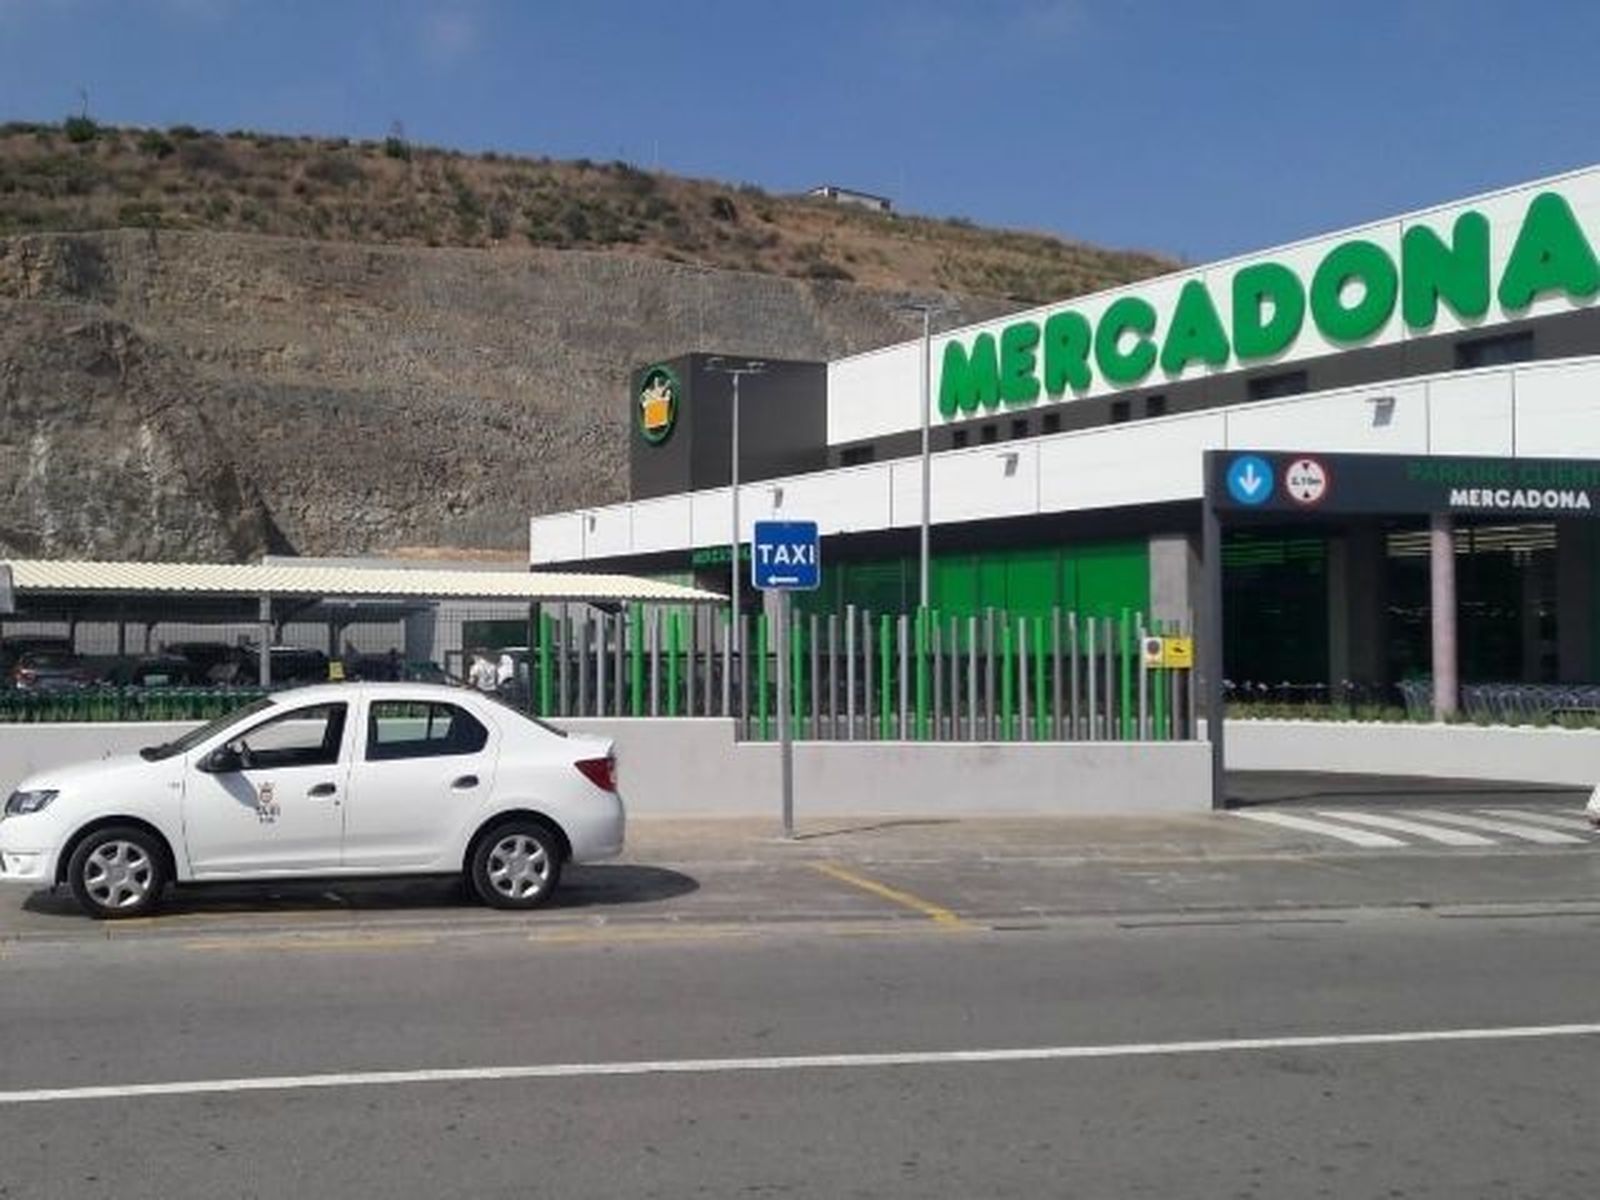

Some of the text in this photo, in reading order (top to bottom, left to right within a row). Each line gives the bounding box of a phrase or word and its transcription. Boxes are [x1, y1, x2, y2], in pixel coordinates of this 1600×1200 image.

[939, 191, 1600, 417] MERCADONA
[1449, 488, 1592, 509] MERCADONA
[757, 544, 815, 564] TAXI
